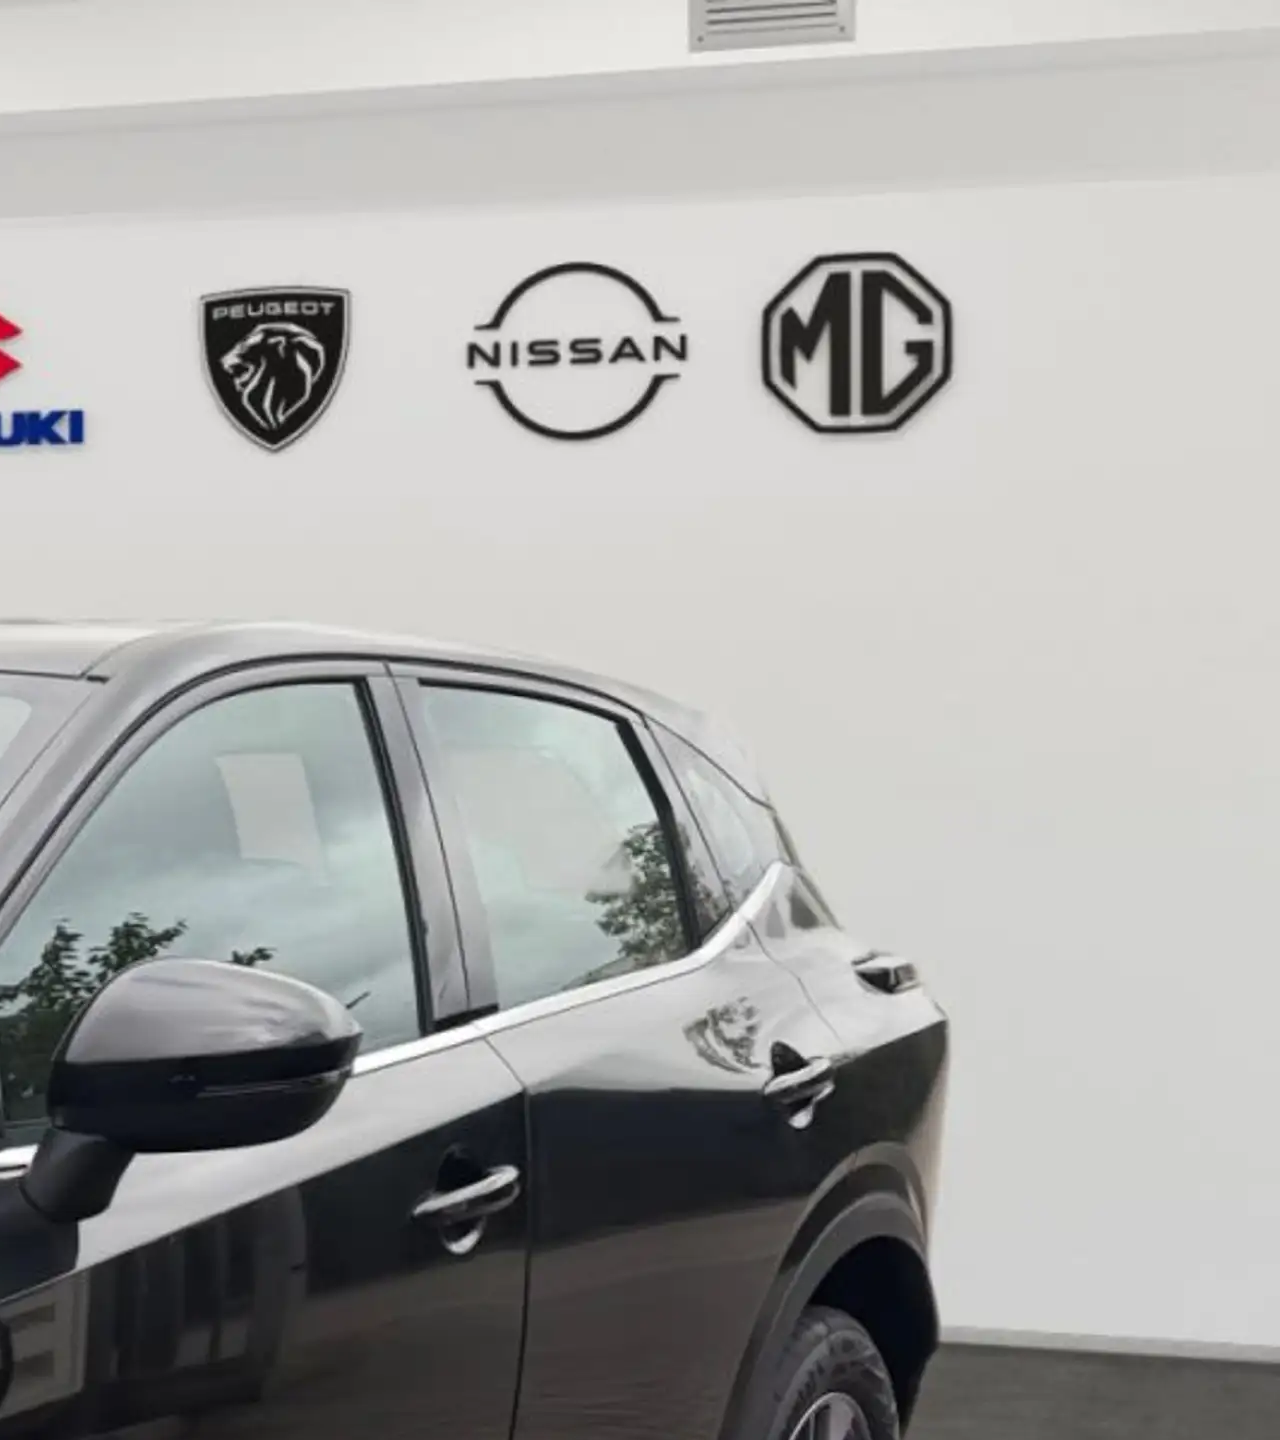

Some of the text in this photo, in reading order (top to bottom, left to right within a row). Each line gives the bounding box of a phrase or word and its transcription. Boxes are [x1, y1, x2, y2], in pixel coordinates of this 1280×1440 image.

[211, 300, 336, 321] PEUGEOT
[466, 333, 689, 370] NISSAN
[778, 270, 935, 418] MG
